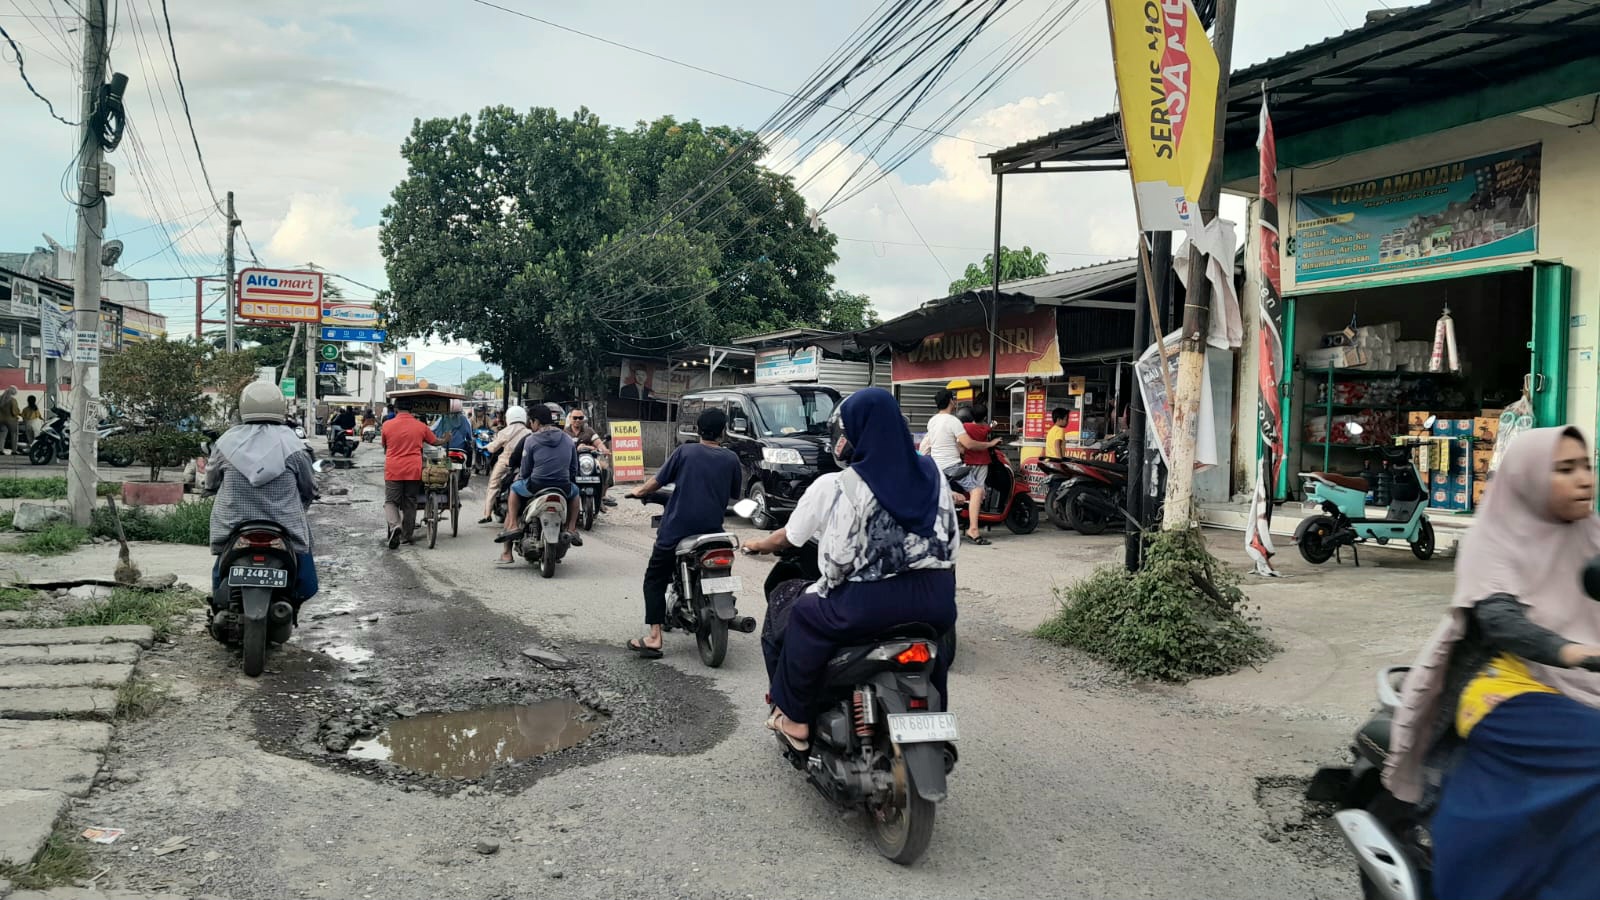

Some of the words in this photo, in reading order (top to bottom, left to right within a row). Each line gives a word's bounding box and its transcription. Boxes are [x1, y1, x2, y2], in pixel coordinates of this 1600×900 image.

[1332, 181, 1377, 206] TOKO
[1381, 162, 1465, 196] AMANAH
[246, 274, 314, 289] Alfamart
[996, 327, 1034, 354] ITRI
[614, 425, 638, 434] KEBAB
[233, 568, 244, 577] DR
[892, 717, 907, 730] DR
[909, 716, 936, 730] 6807
